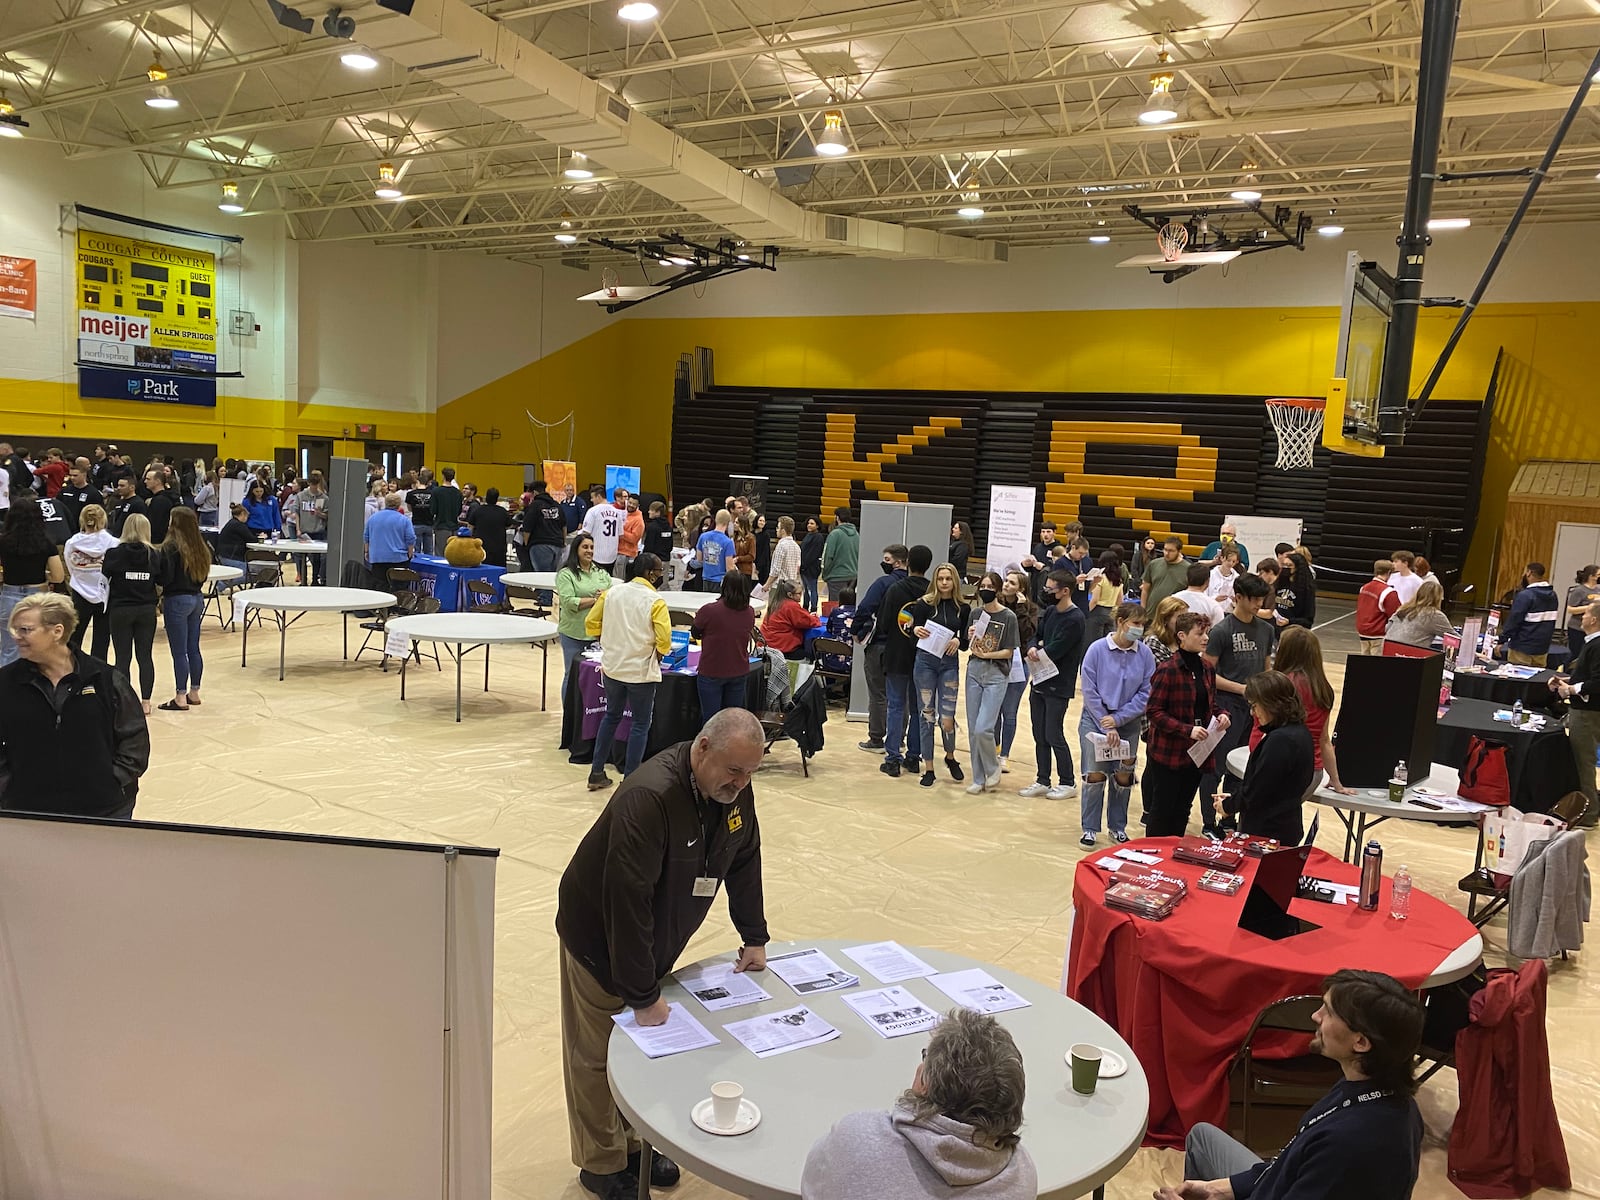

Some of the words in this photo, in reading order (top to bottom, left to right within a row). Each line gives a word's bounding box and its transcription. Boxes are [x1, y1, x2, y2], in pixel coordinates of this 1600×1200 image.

[78, 253, 115, 267] COUGARS
[88, 239, 141, 257] COUGAR
[151, 249, 207, 269] COUNTRY
[189, 271, 211, 283] GUEST
[81, 315, 149, 342] meijer
[153, 327, 181, 338] ALLEN
[181, 329, 215, 341] SPRIGGS
[143, 378, 180, 397] Park
[600, 510, 618, 518] PIAZZA
[602, 519, 617, 537] 31
[125, 571, 150, 581] HUNTER
[1232, 632, 1249, 643] EAT.
[1232, 640, 1258, 652] SLEEP.
[885, 1015, 936, 1032] PSYCHOLOGY
